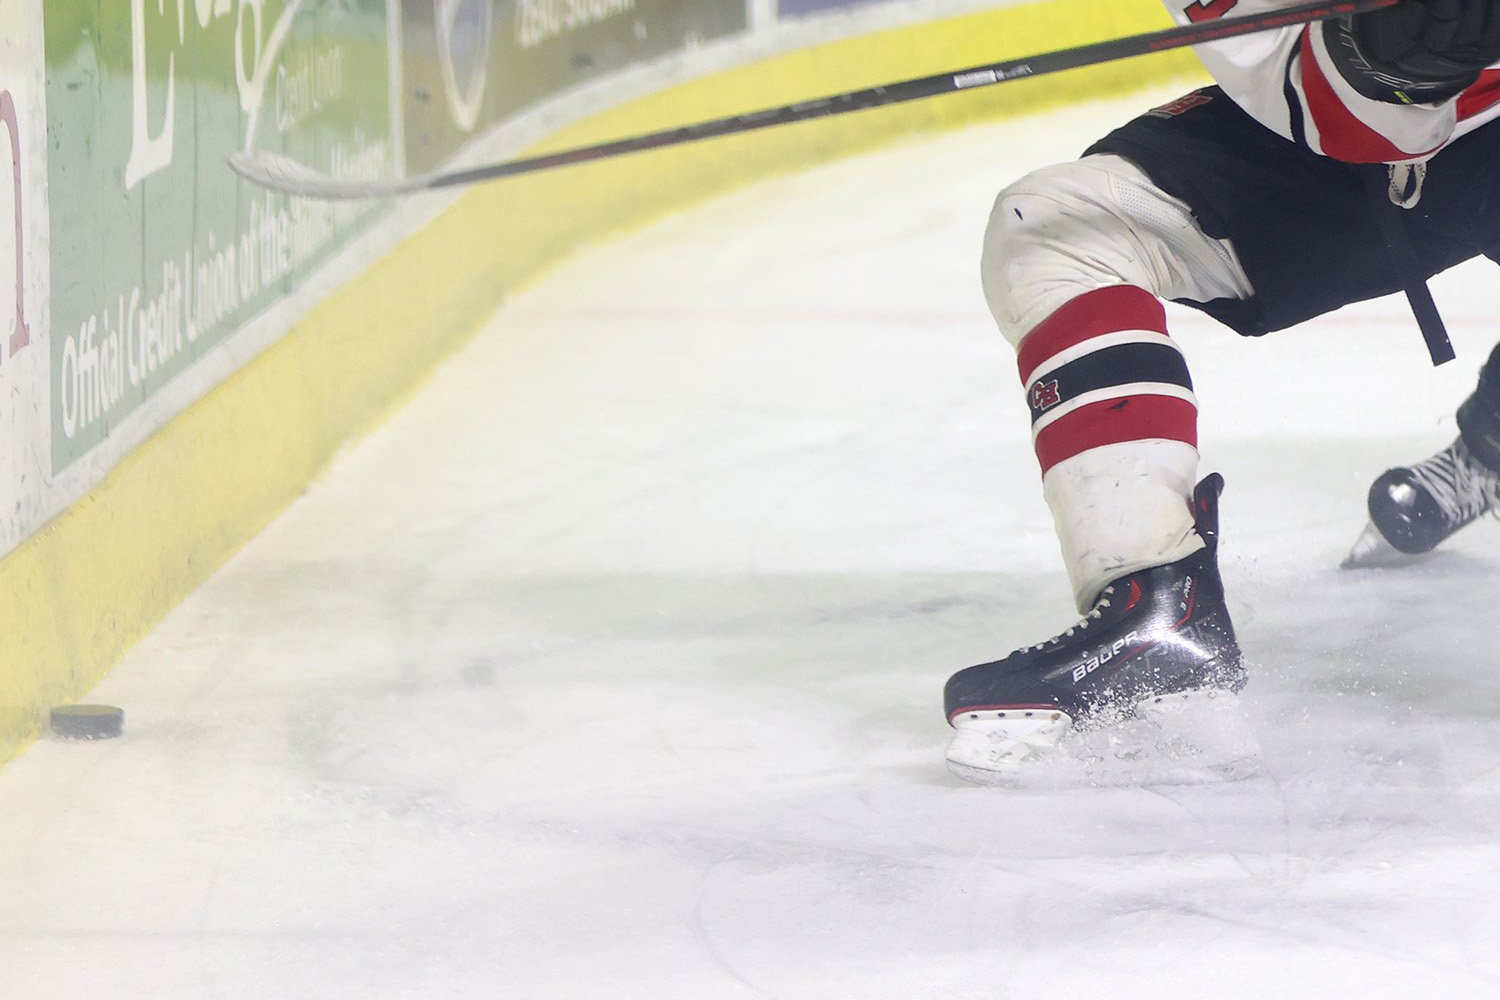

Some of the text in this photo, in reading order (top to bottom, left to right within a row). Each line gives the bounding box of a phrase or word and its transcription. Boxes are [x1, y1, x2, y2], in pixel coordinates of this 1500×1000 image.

[61, 294, 124, 439] Official
[127, 259, 182, 388] Credit
[184, 231, 240, 343] Union
[239, 196, 259, 301] of
